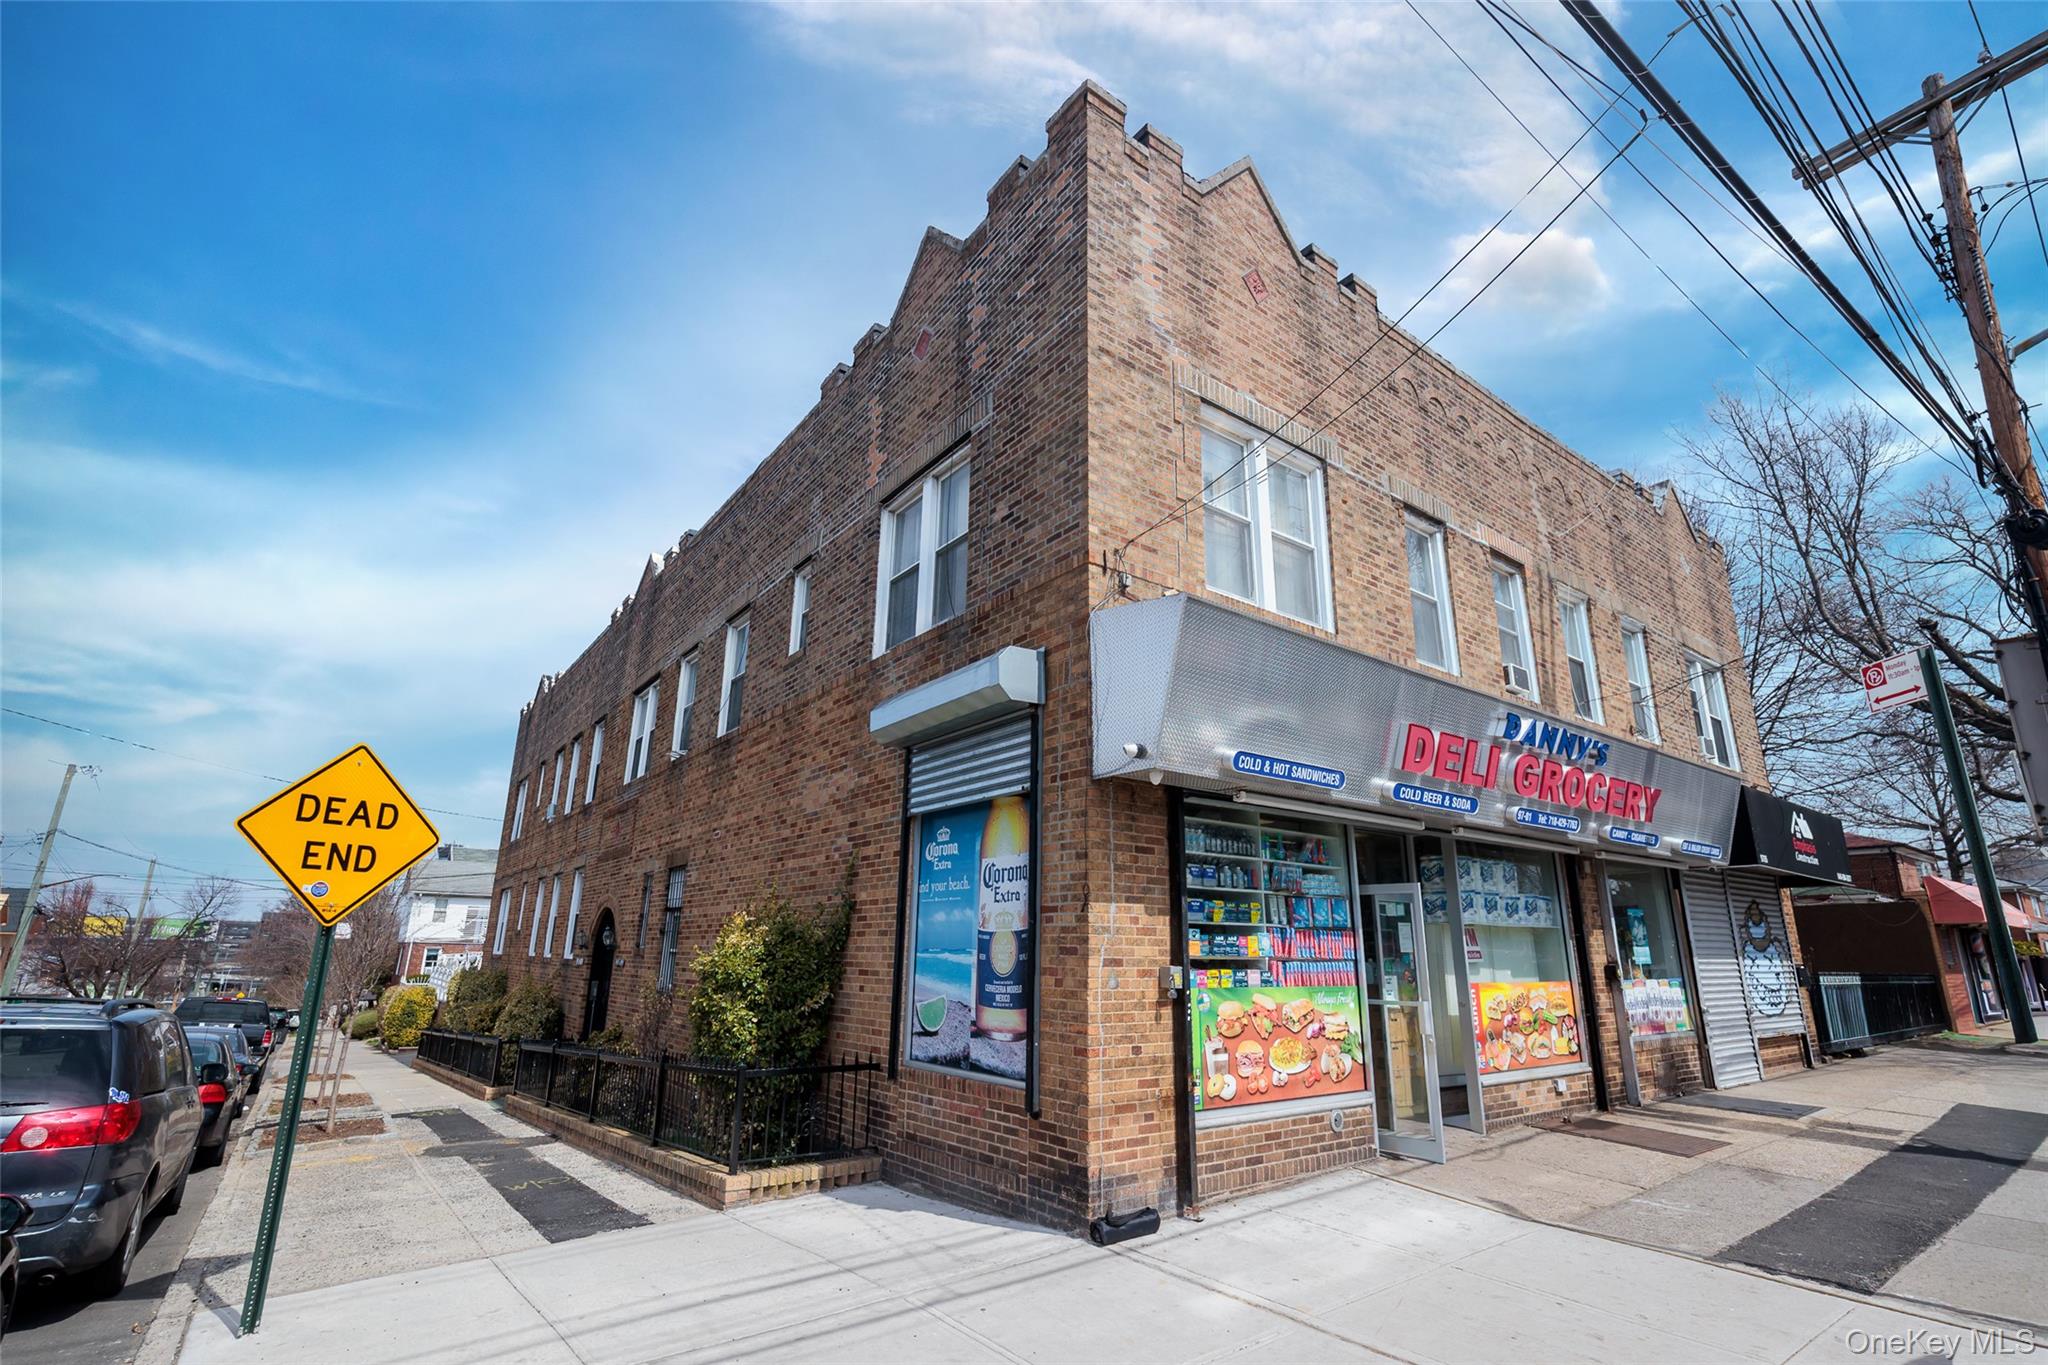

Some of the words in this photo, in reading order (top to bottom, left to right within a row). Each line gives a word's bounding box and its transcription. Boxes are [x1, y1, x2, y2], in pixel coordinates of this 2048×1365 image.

[1503, 712, 1609, 767] DANNY'S
[1239, 755, 1261, 771] COLD
[1264, 760, 1270, 773] &
[1273, 762, 1290, 776] HOT
[1291, 766, 1340, 785] SANDWICHES
[1401, 723, 1502, 790] DELI
[1514, 753, 1661, 823] GROCERY
[295, 793, 399, 830] DEAD
[1400, 787, 1421, 801] COLD
[1423, 791, 1442, 805] BEER
[1444, 796, 1450, 807] &
[1451, 797, 1471, 810] SODA
[301, 840, 377, 873] END
[925, 842, 959, 862] Corona
[933, 858, 952, 870] Extra
[919, 879, 929, 893] ind
[930, 882, 947, 898] your
[948, 874, 971, 891] beach.
[983, 862, 1028, 891] Corona
[994, 886, 1021, 904] Extra
